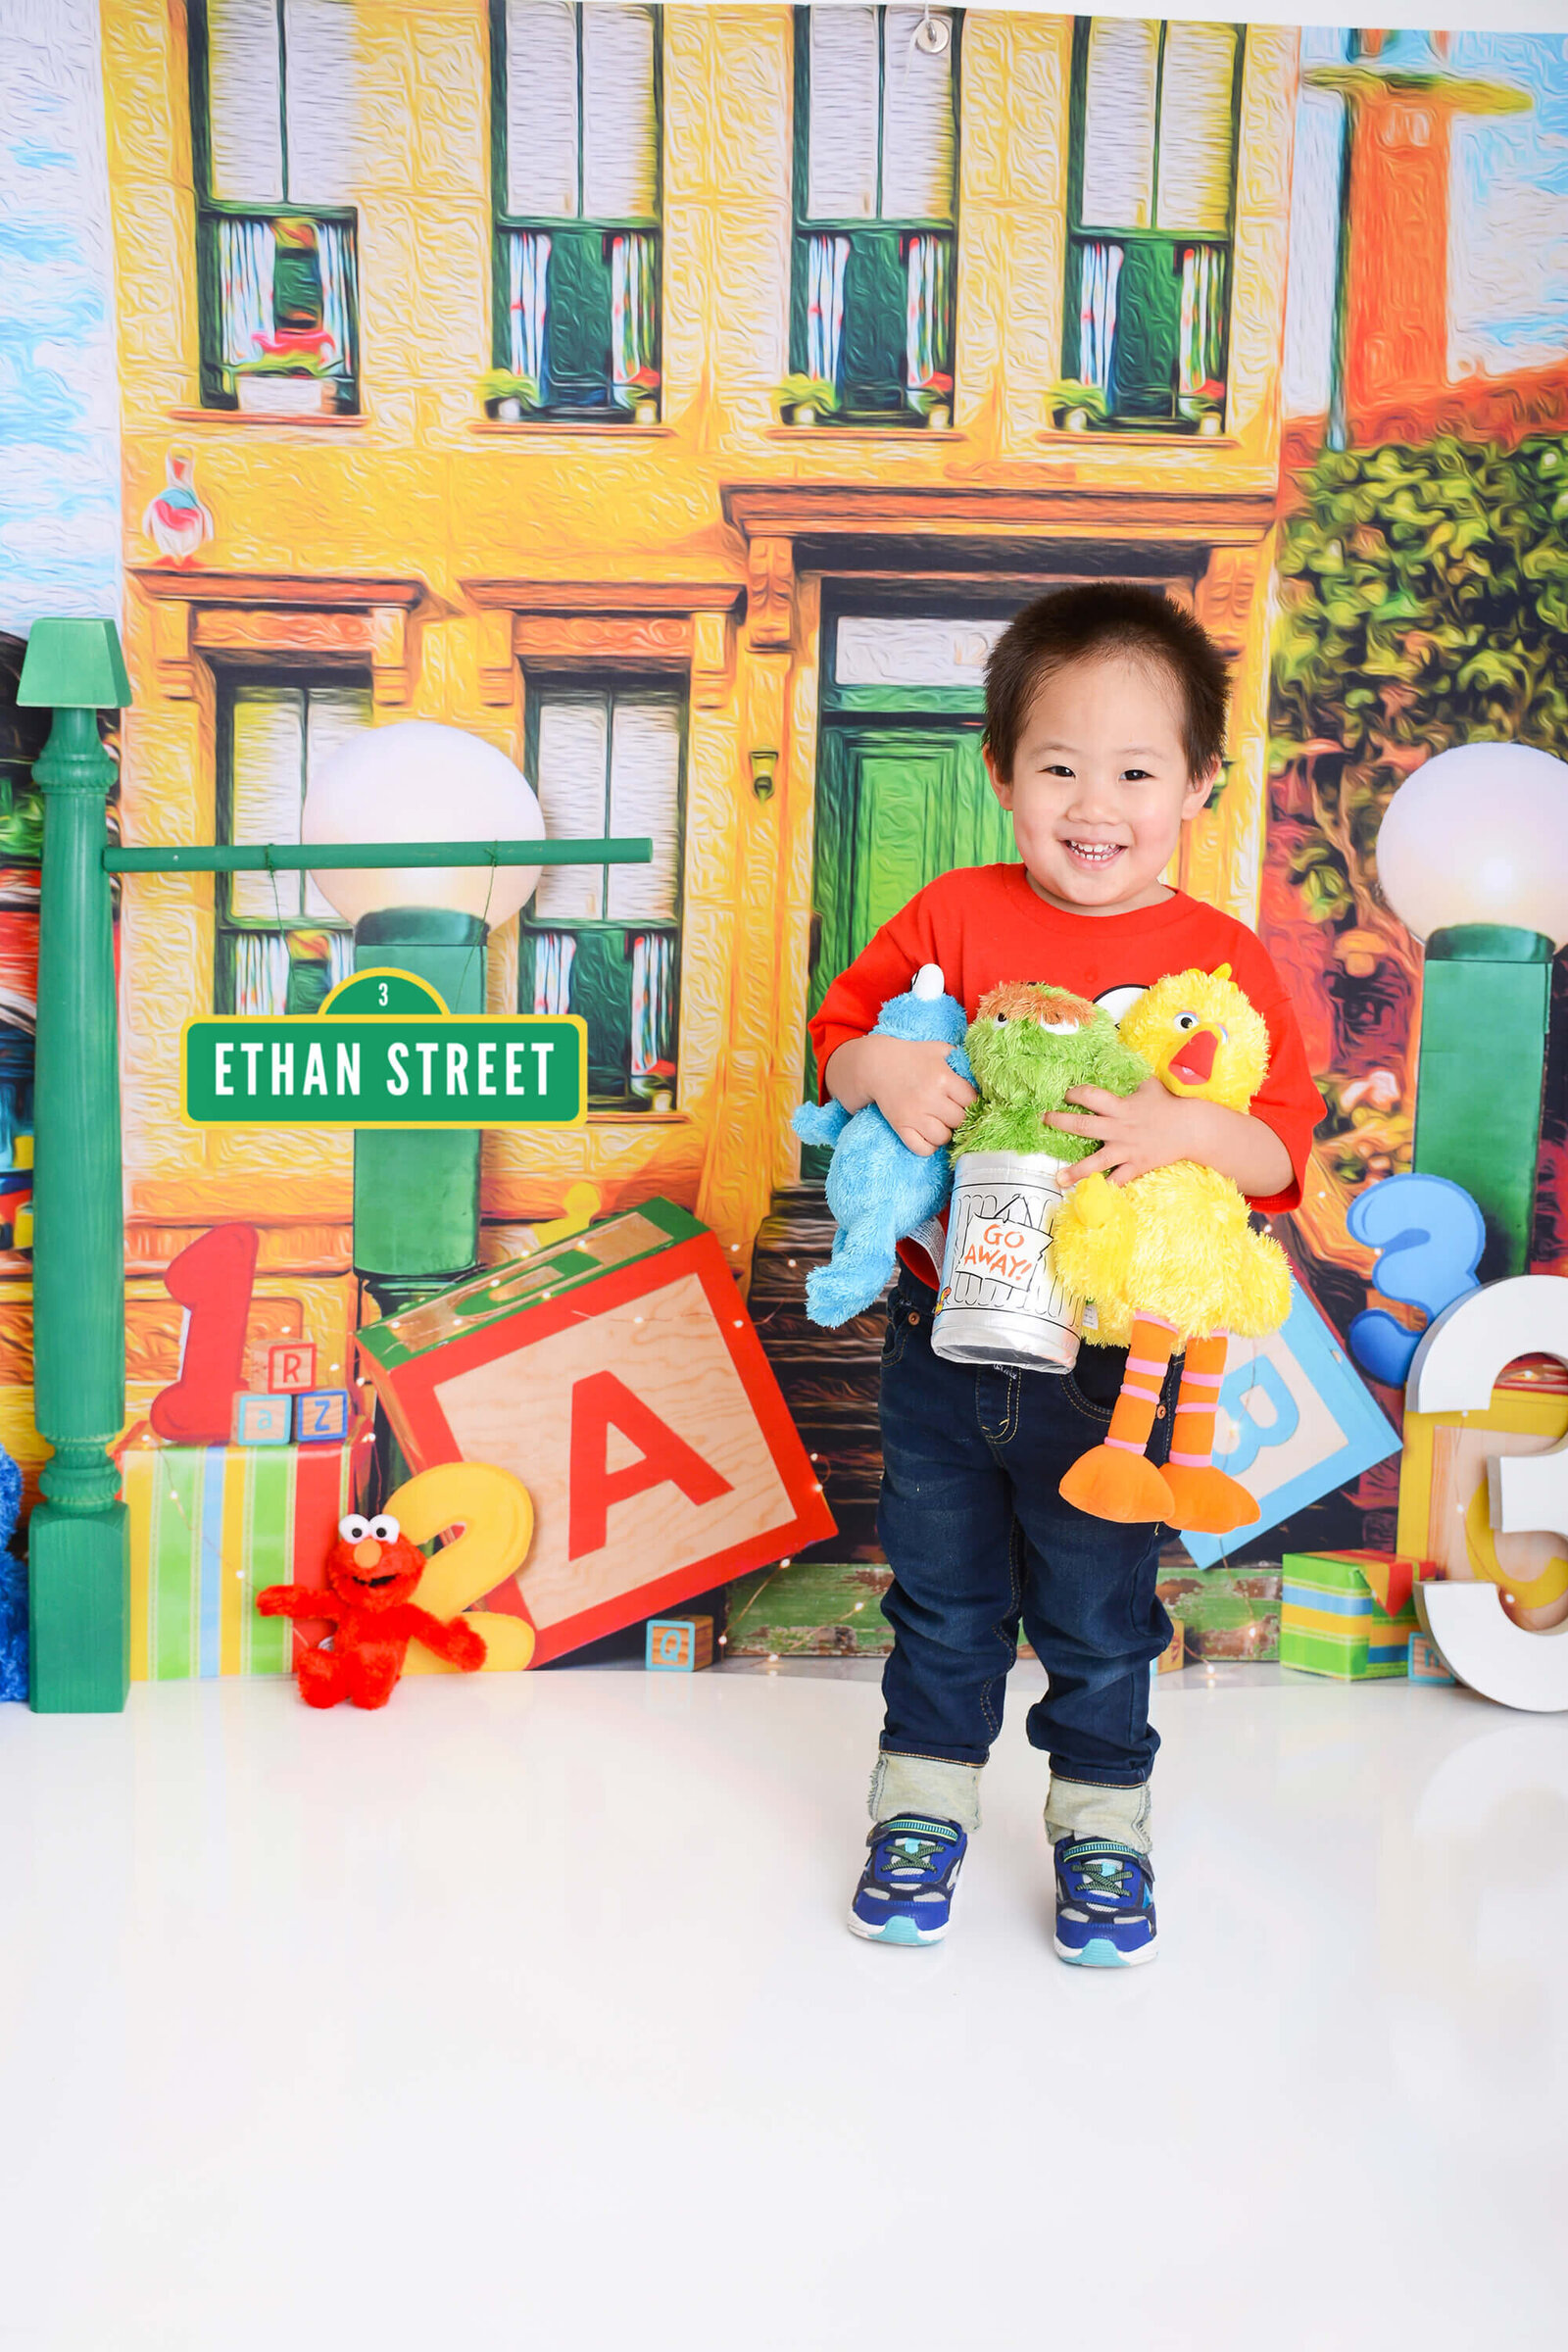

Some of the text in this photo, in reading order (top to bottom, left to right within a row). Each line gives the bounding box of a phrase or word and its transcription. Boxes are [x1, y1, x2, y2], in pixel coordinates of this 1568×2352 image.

[377, 982, 389, 1007] 3
[215, 1042, 555, 1097] ETHAN STREET
[983, 1223, 1025, 1249] GO
[963, 1244, 1032, 1282] AWAY!
[1346, 1172, 1487, 1391] 3
[150, 1221, 259, 1442] 1
[283, 1352, 302, 1384] R
[257, 1409, 272, 1430] a
[314, 1399, 331, 1432] Z
[568, 1369, 736, 1562] A
[1405, 1274, 1568, 1713] 3
[383, 1461, 535, 1675] 2
[660, 1629, 682, 1663] Q
